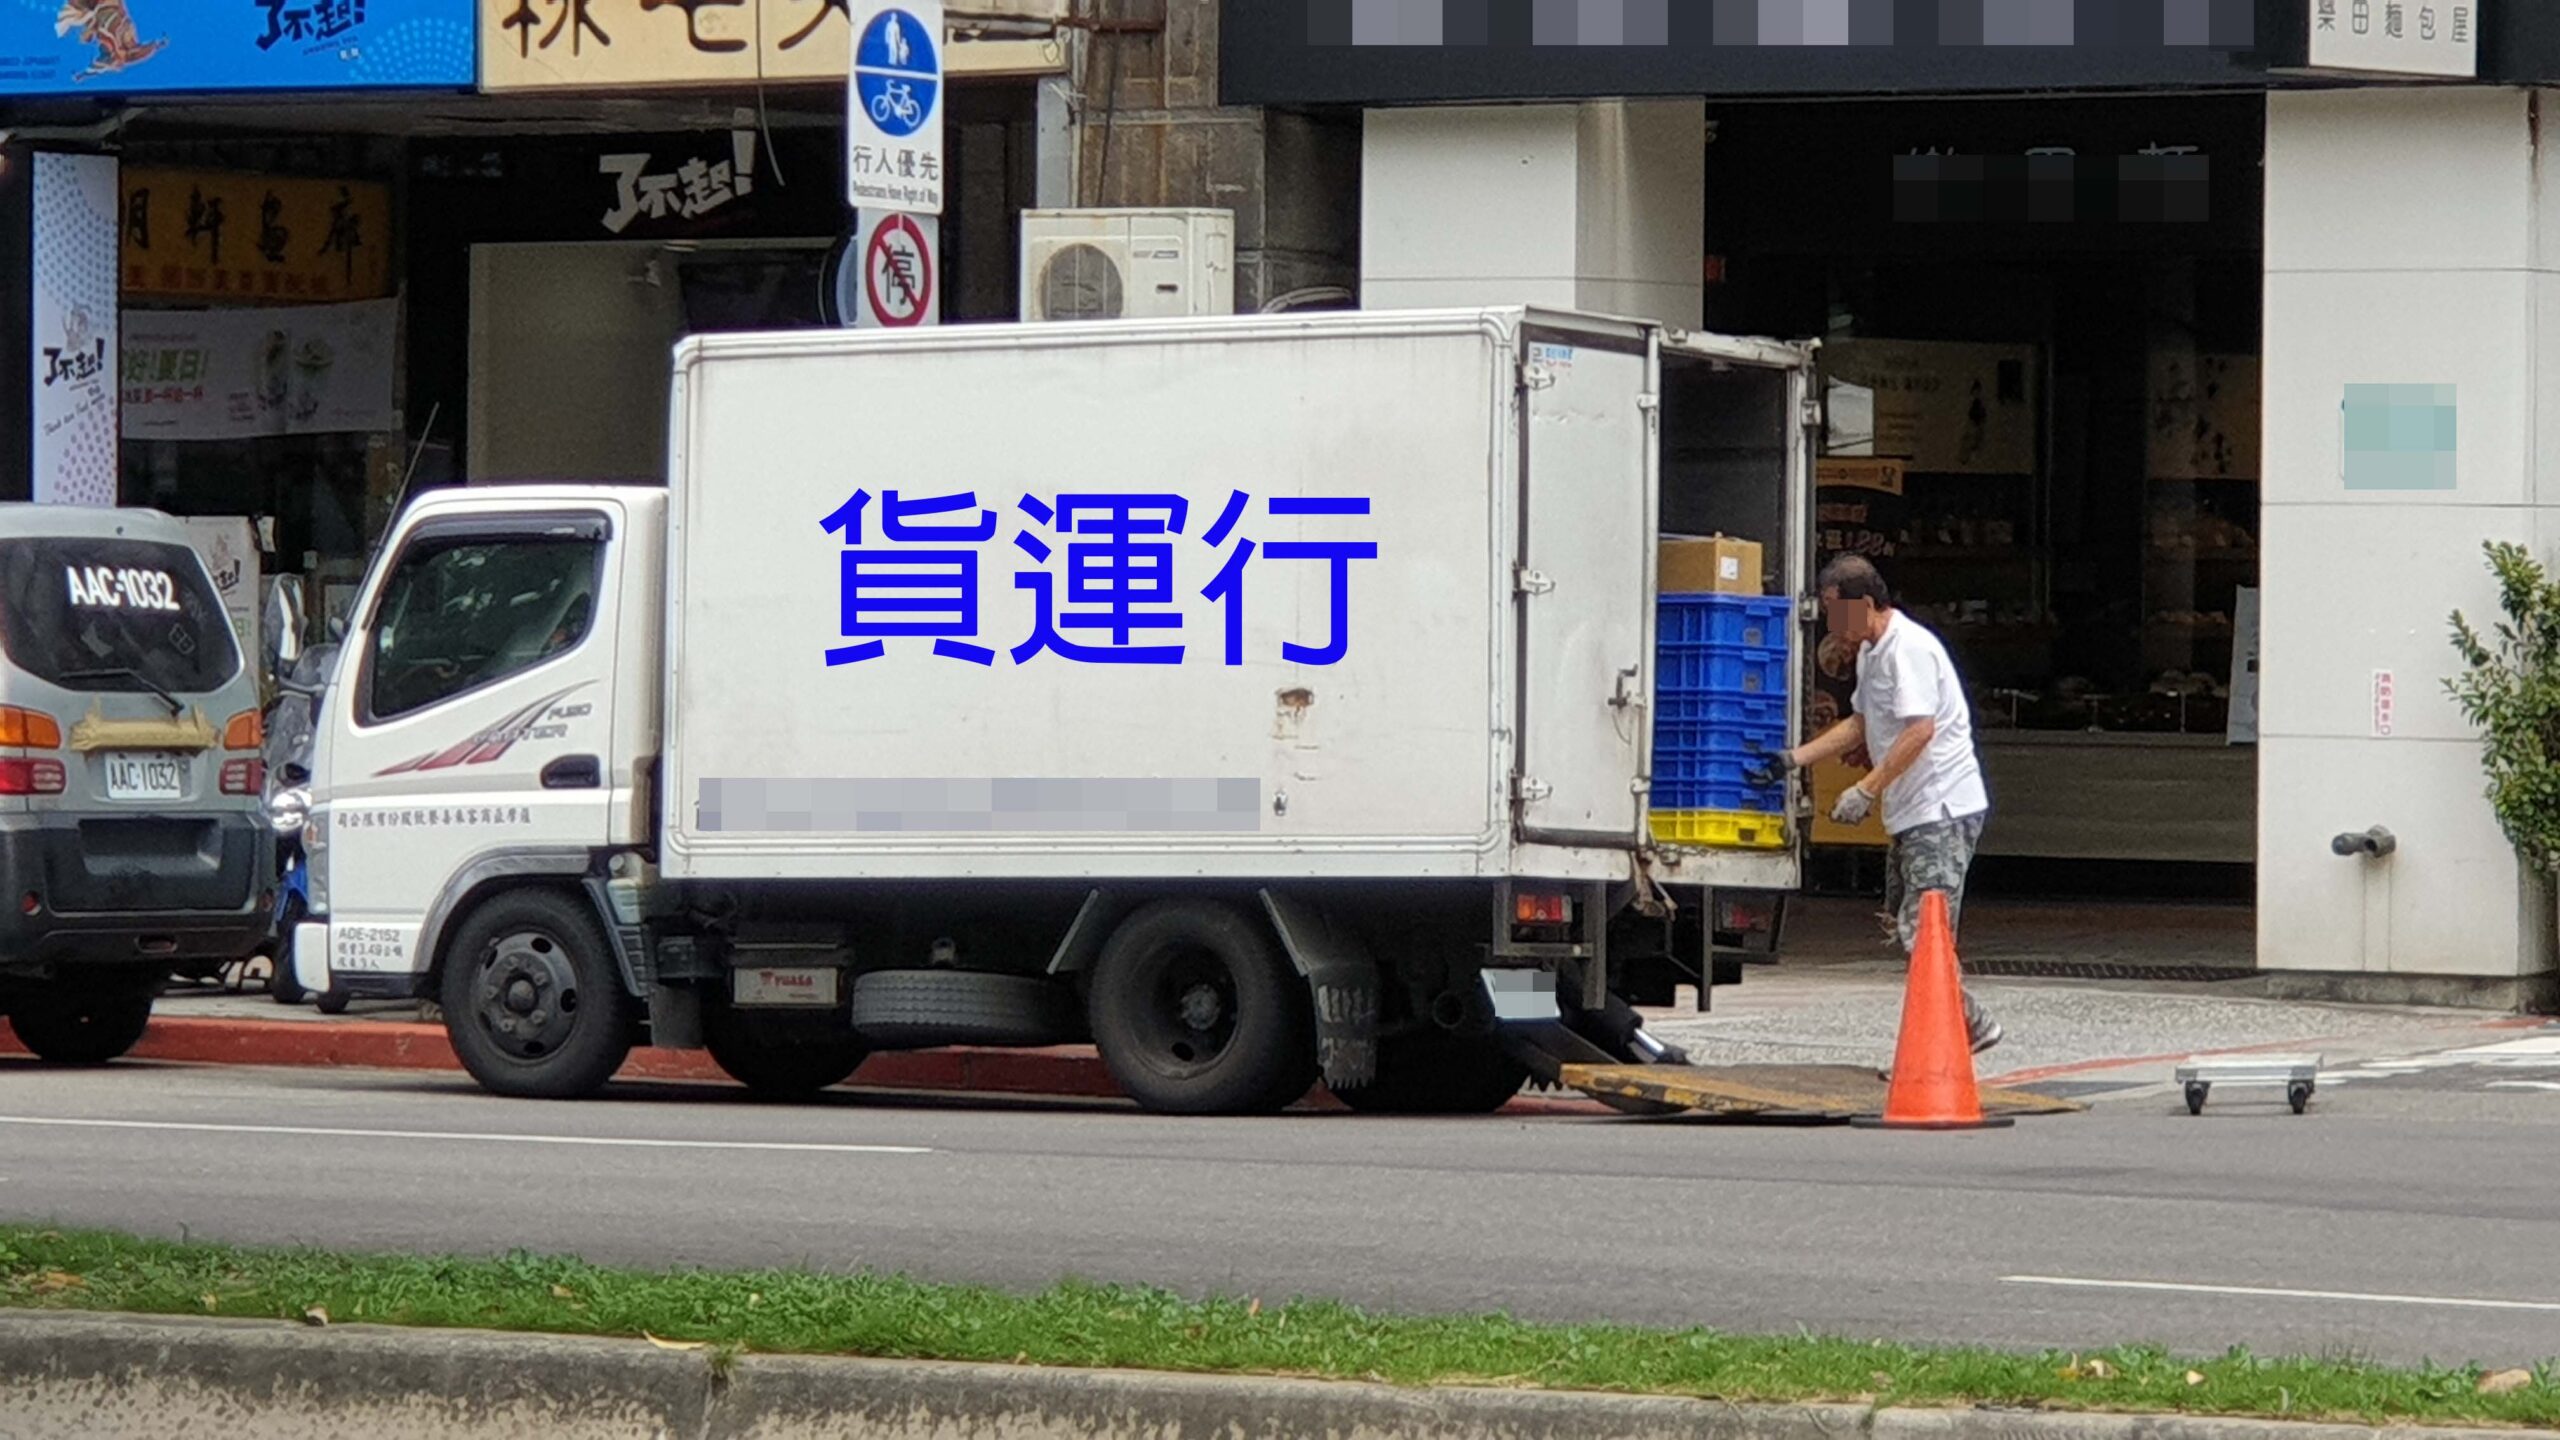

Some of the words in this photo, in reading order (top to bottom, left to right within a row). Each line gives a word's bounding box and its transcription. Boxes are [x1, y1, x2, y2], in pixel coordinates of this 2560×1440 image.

[599, 131, 757, 234] 了不起!
[853, 145, 939, 181] 行人優先
[881, 244, 916, 306] 停
[43, 338, 105, 387] 了不起!
[66, 565, 180, 611] AAC-1032
[111, 761, 180, 791] AAC-1032
[339, 927, 400, 942] ADE-2152
